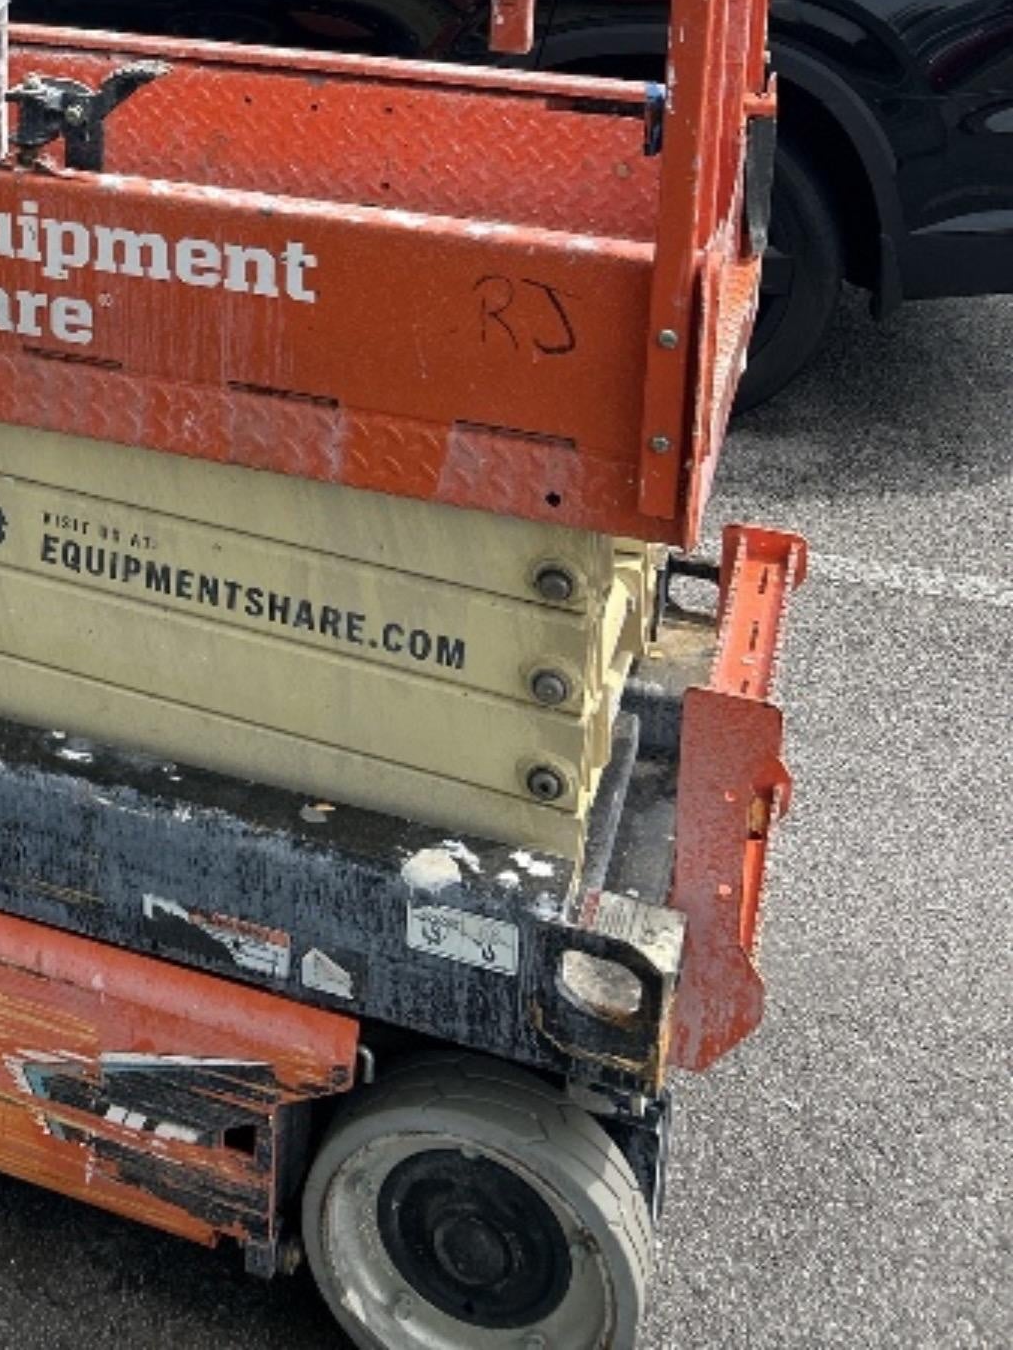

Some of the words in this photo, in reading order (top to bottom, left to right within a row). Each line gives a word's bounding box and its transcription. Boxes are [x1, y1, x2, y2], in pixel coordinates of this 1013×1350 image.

[472, 274, 578, 355] RJ
[43, 512, 90, 535] VISIT
[41, 533, 466, 670] EQUIPMENTSHARE.COM
